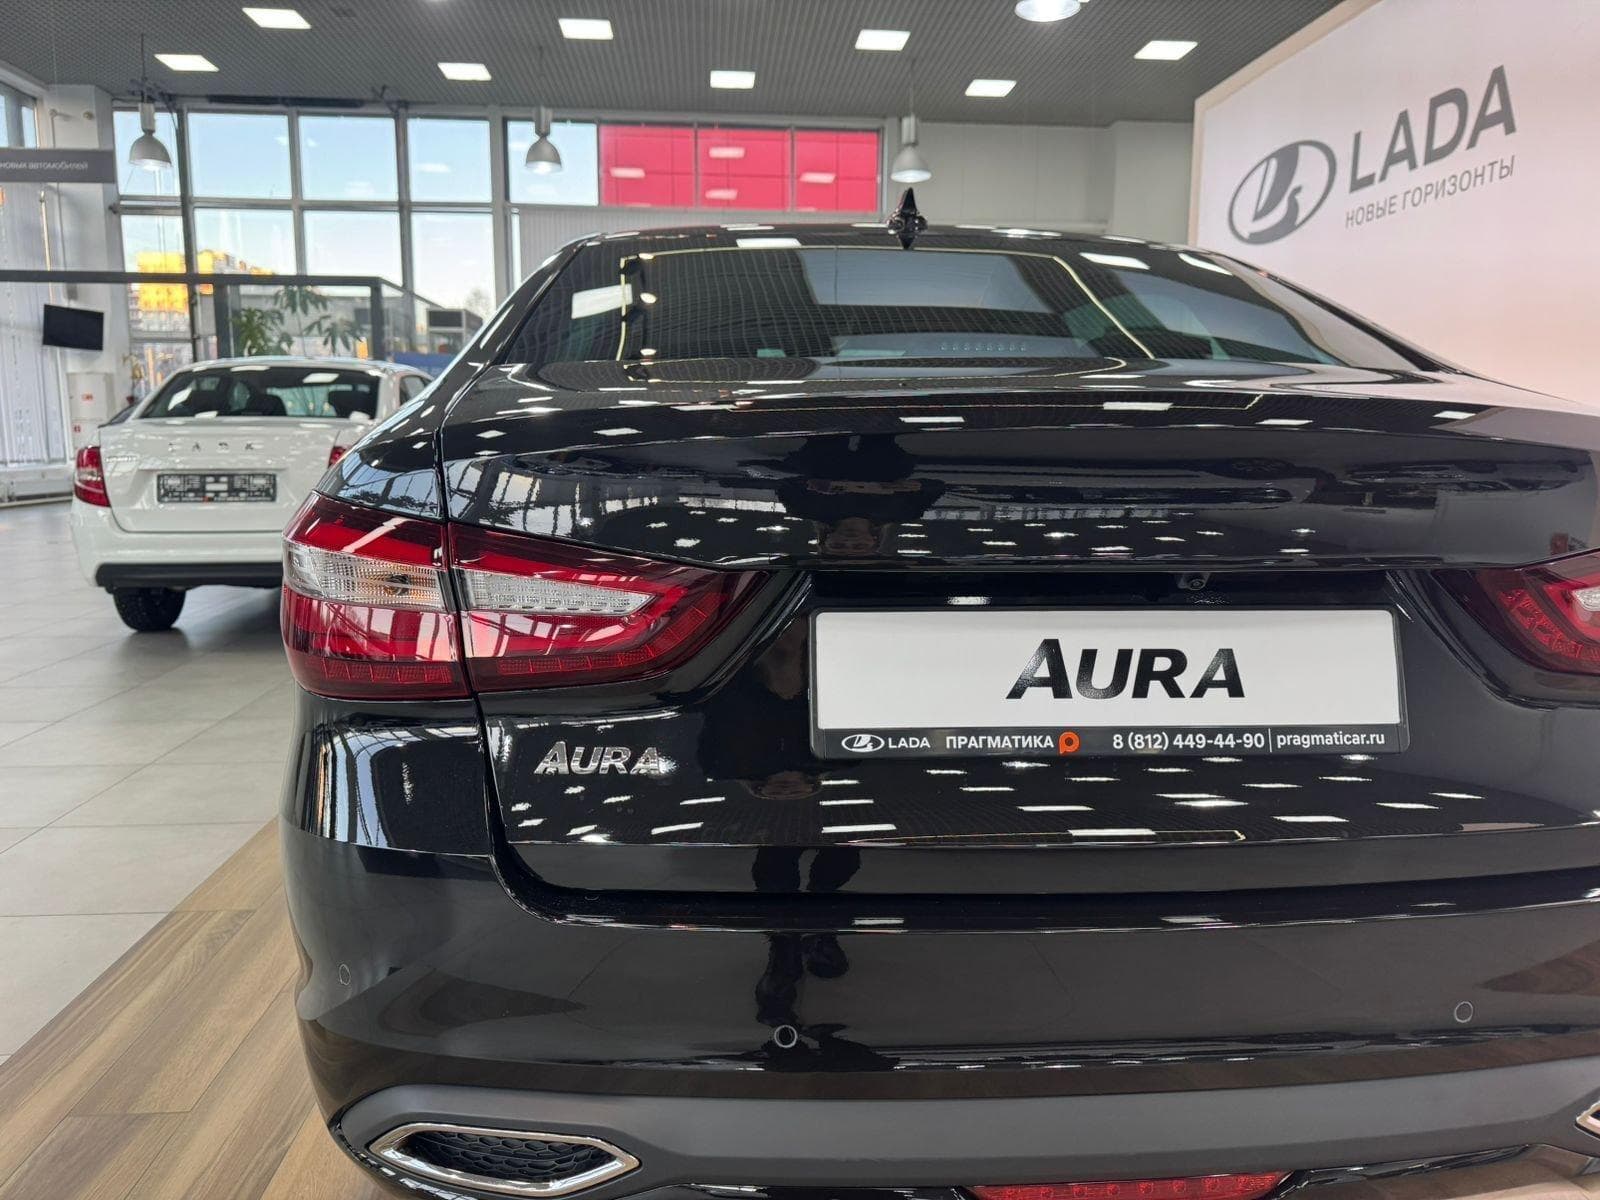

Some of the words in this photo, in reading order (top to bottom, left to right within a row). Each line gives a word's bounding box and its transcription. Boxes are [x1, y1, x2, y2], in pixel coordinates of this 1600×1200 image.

[1349, 64, 1517, 194] LADA
[1345, 194, 1397, 228] НОВЫЕ
[1401, 155, 1516, 211] ГОРИЗОНТЫ
[1005, 638, 1245, 700] AURA
[888, 737, 931, 749] LADA
[946, 735, 1054, 749] ПРАГМАТИКА
[1112, 734, 1124, 749] 8
[1128, 732, 1169, 750] (812)
[1173, 733, 1265, 749] 449-44-90
[1276, 732, 1385, 747] pragmaticar.ru
[534, 740, 663, 775] AURA
